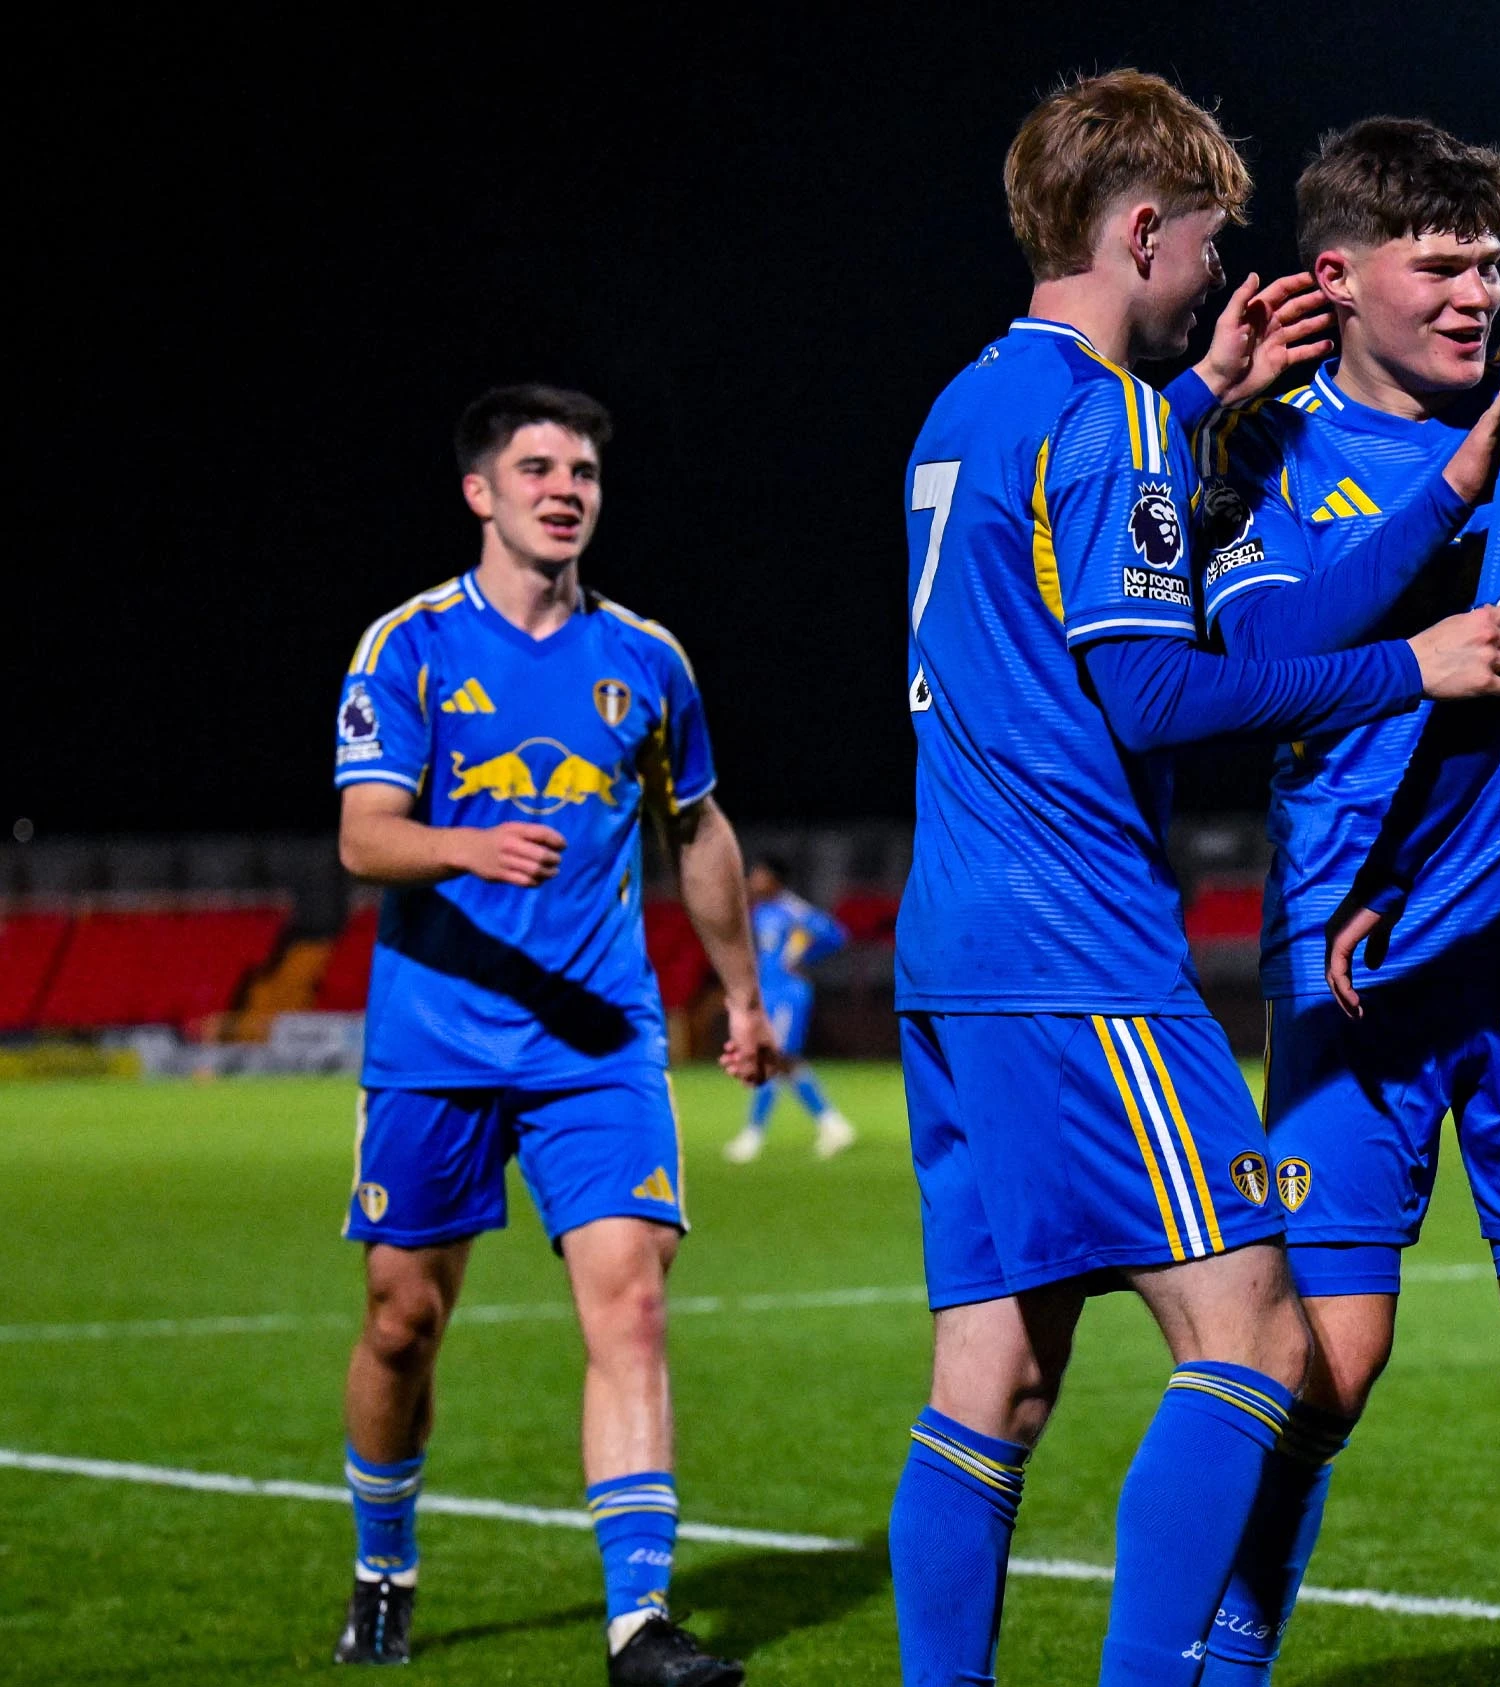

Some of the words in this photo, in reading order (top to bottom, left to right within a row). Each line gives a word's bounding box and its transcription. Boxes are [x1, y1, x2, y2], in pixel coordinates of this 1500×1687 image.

[1205, 571, 1219, 590] for
[1219, 551, 1265, 577] racism
[1206, 560, 1218, 575] No
[1216, 543, 1256, 566] room
[911, 460, 962, 713] 7
[1123, 567, 1147, 585] No
[1149, 573, 1185, 593] room
[1123, 581, 1147, 598] for
[1148, 585, 1192, 607] racism
